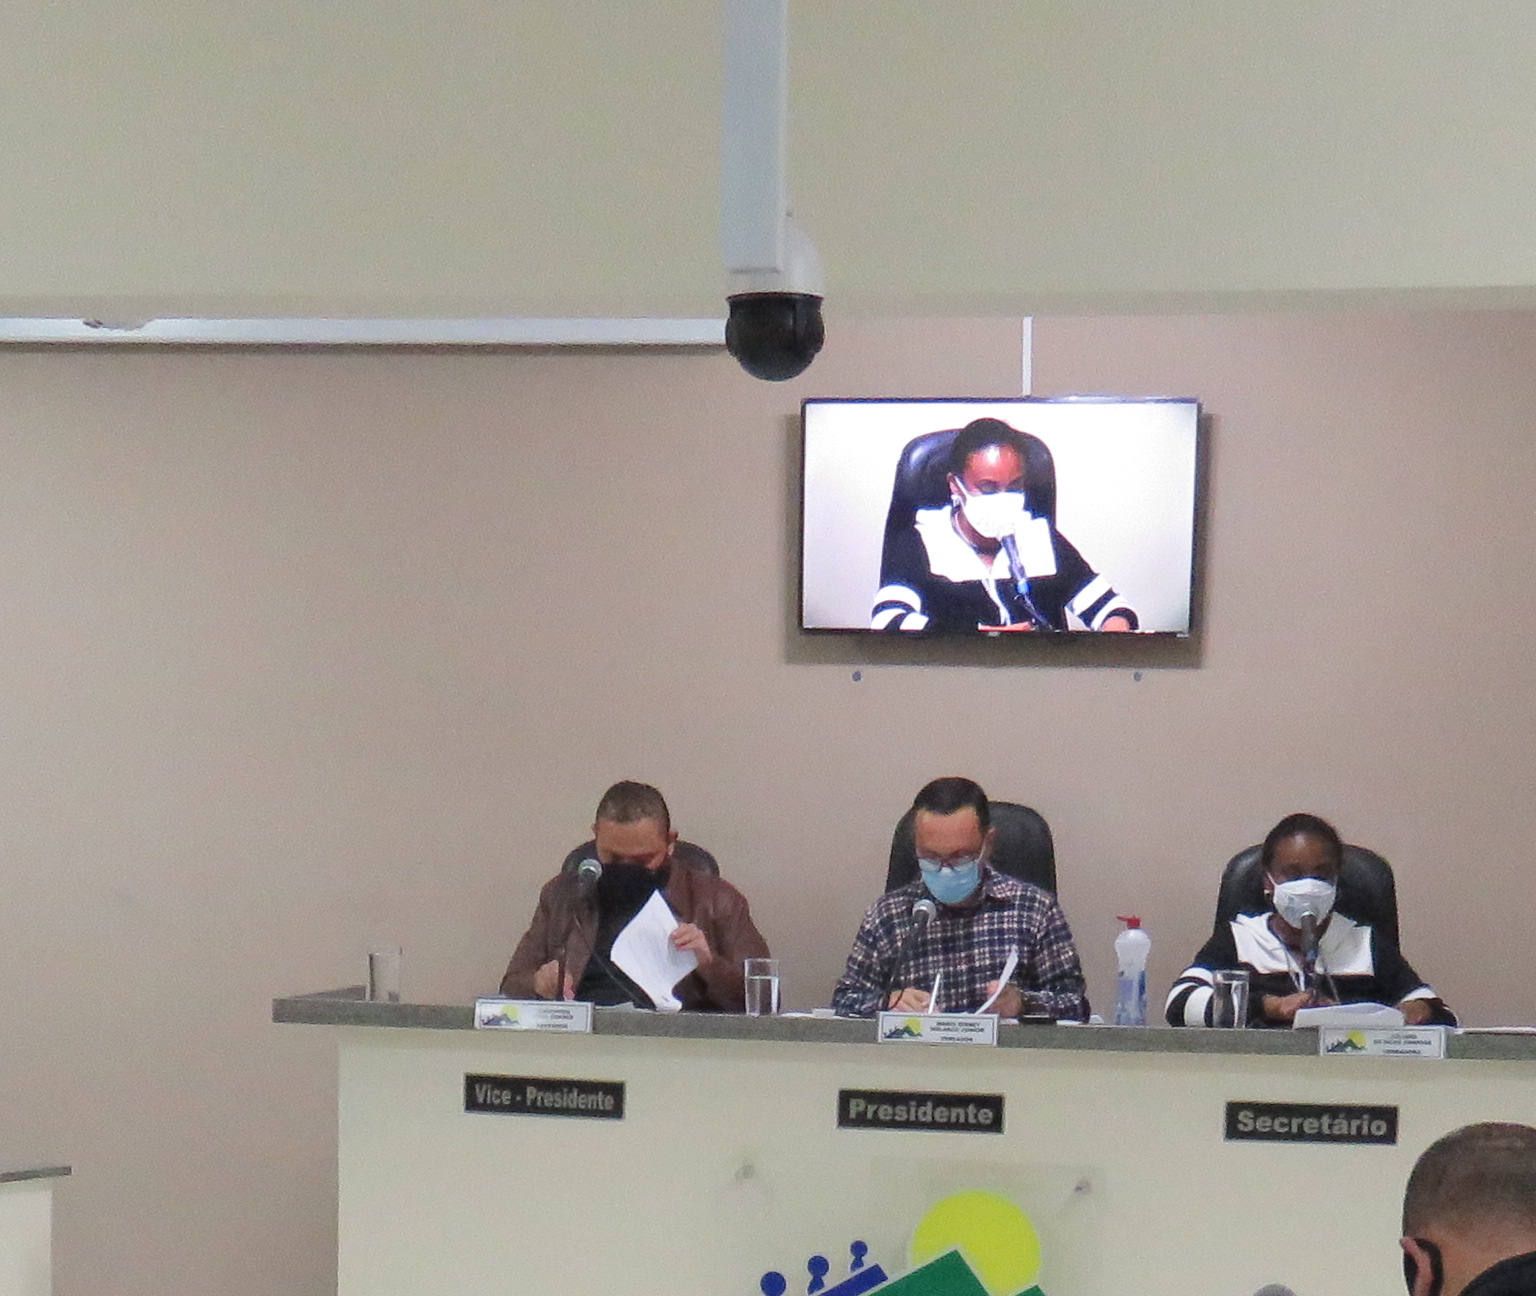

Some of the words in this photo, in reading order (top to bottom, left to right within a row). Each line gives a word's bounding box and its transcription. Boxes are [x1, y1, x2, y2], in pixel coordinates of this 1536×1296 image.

[475, 1083, 511, 1105] Vice
[526, 1086, 614, 1111] Presidente
[848, 1098, 994, 1125] Presidente
[1236, 1111, 1387, 1136] Secretário
